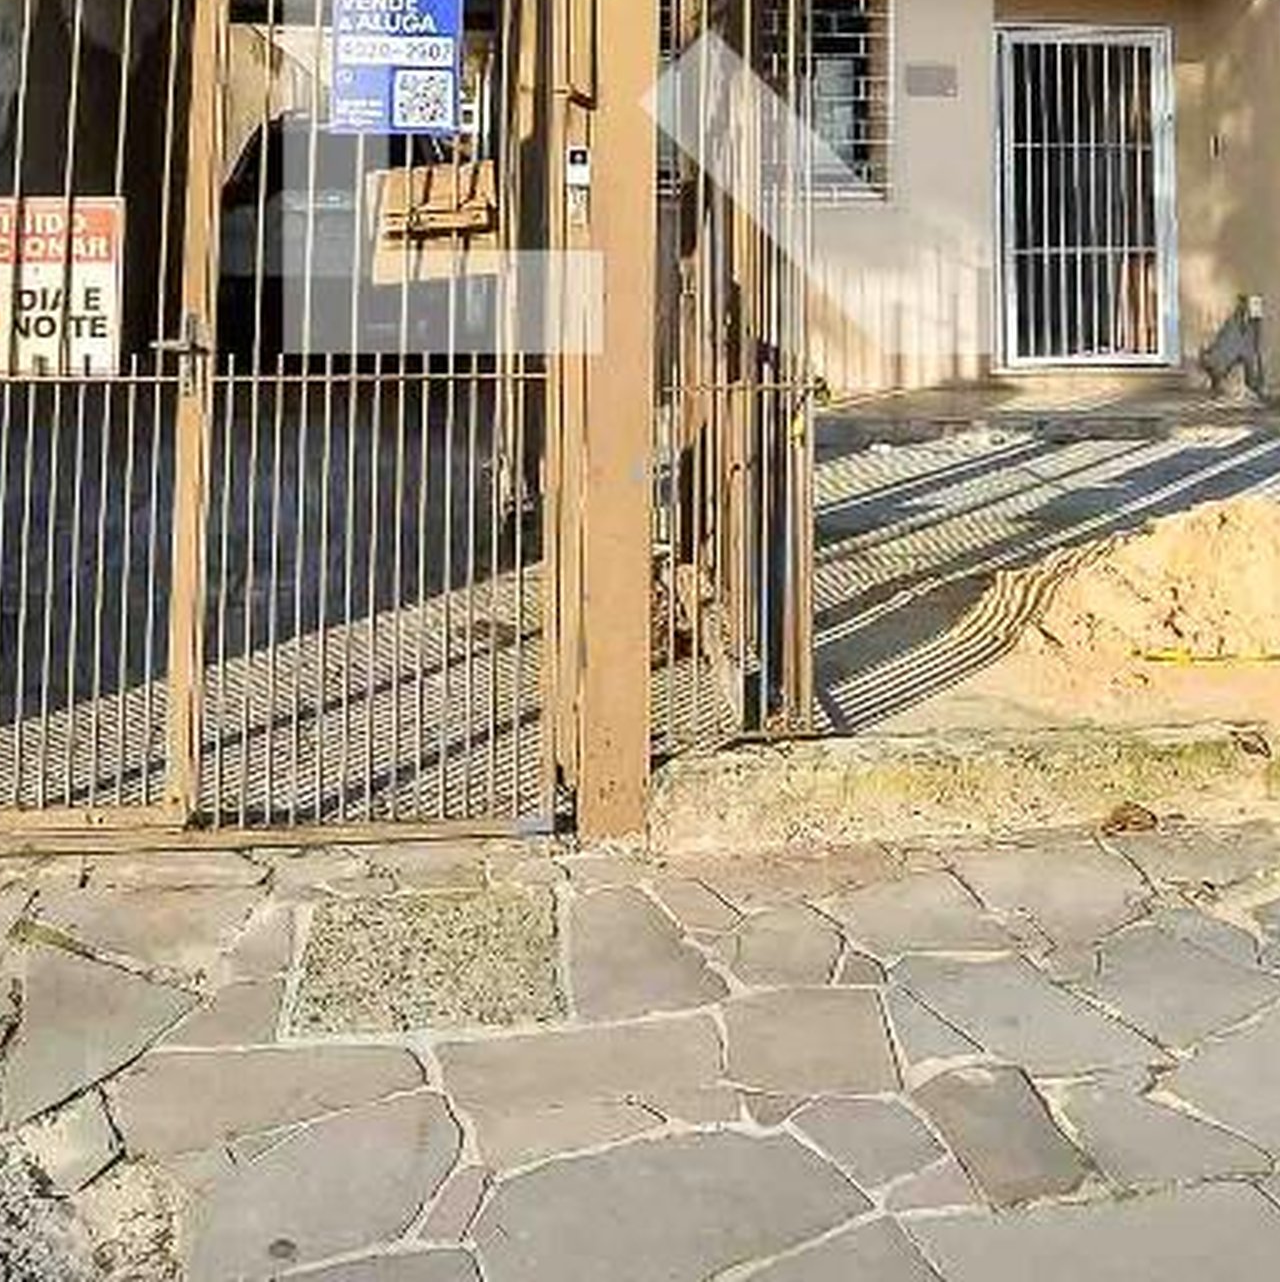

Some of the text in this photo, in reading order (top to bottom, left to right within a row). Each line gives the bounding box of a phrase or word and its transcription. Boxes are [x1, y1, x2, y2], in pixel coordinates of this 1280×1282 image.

[356, 12, 438, 34] ALUGA
[84, 287, 102, 311] E
[12, 315, 107, 339] NOTE
